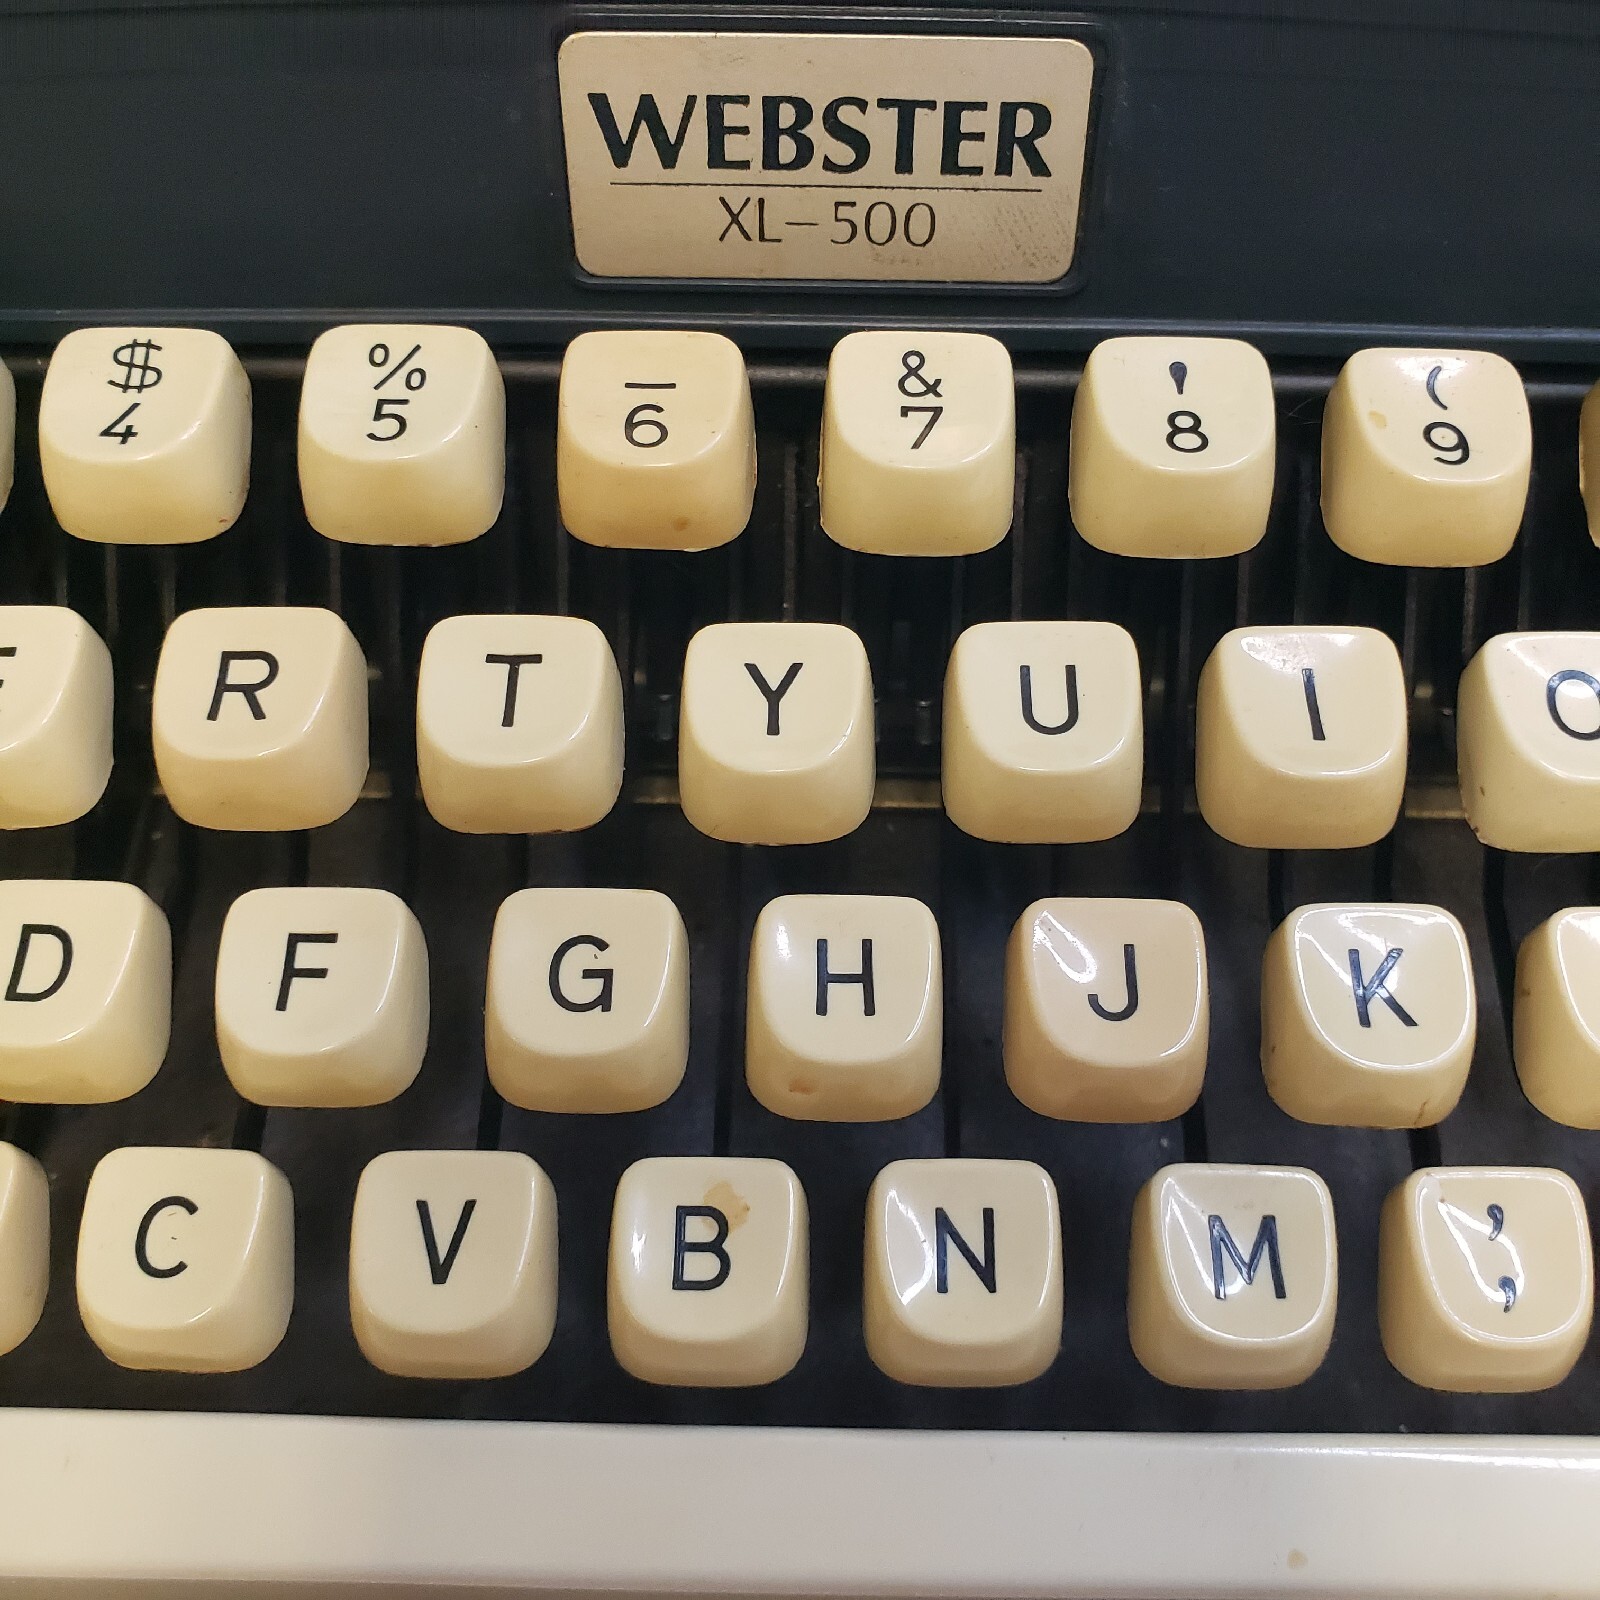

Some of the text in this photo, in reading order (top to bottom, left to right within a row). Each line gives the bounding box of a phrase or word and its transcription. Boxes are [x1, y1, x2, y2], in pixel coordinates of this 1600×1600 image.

[586, 92, 1053, 178] WEBSTER
[107, 338, 163, 394] $
[368, 343, 427, 392] %
[897, 349, 943, 398] &
[1426, 365, 1448, 411] (
[99, 402, 141, 445] 4
[366, 398, 410, 442] 5
[624, 403, 669, 449] 6
[900, 405, 944, 450] 7
[1165, 410, 1209, 454] 8
[1422, 421, 1470, 466] 9
[206, 650, 280, 722] R
[484, 653, 543, 728] T
[743, 662, 804, 736] Y
[1019, 664, 1079, 736] U
[1546, 669, 1600, 741] O
[4, 923, 73, 1003] D
[275, 932, 339, 1012] F
[548, 934, 614, 1013] G
[815, 938, 876, 1017] H
[1087, 943, 1139, 1022] J
[1348, 948, 1418, 1029] K
[134, 1195, 199, 1279] C
[415, 1198, 478, 1285] V
[671, 1204, 732, 1292] B
[934, 1206, 997, 1294] N
[1207, 1214, 1287, 1301] M
